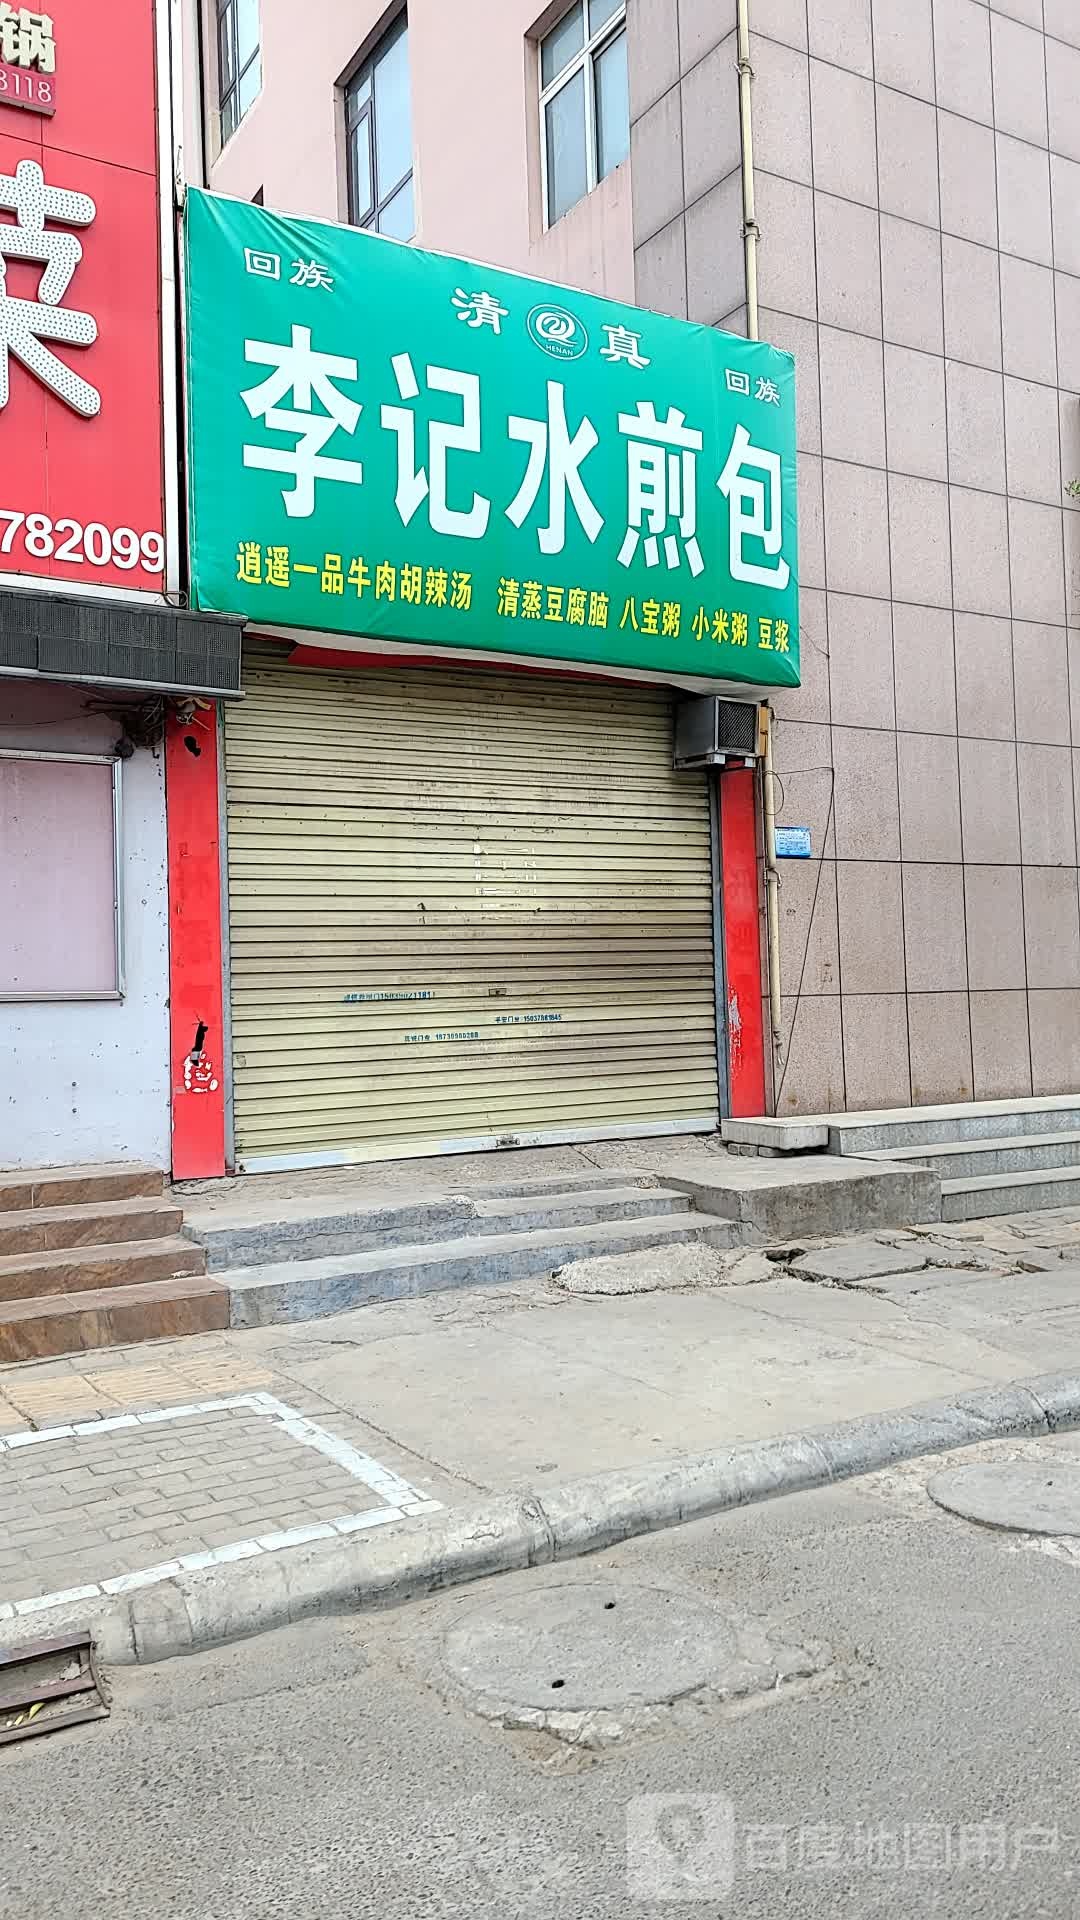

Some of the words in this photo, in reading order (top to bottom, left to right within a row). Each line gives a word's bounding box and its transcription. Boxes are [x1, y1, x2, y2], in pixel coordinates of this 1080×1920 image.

[244, 247, 334, 292] 回族
[545, 344, 574, 356] HENAN
[725, 369, 781, 406] 回族
[239, 323, 790, 591] 李记水煎包
[0, 509, 165, 573] 782099
[235, 541, 473, 610] 逍遥一品牛肉胡辣汤
[497, 577, 609, 629] 清蒸豆腐脑
[620, 597, 681, 638] 八宝粥
[691, 606, 748, 647] 小米粥
[758, 617, 790, 653] 豆浆
